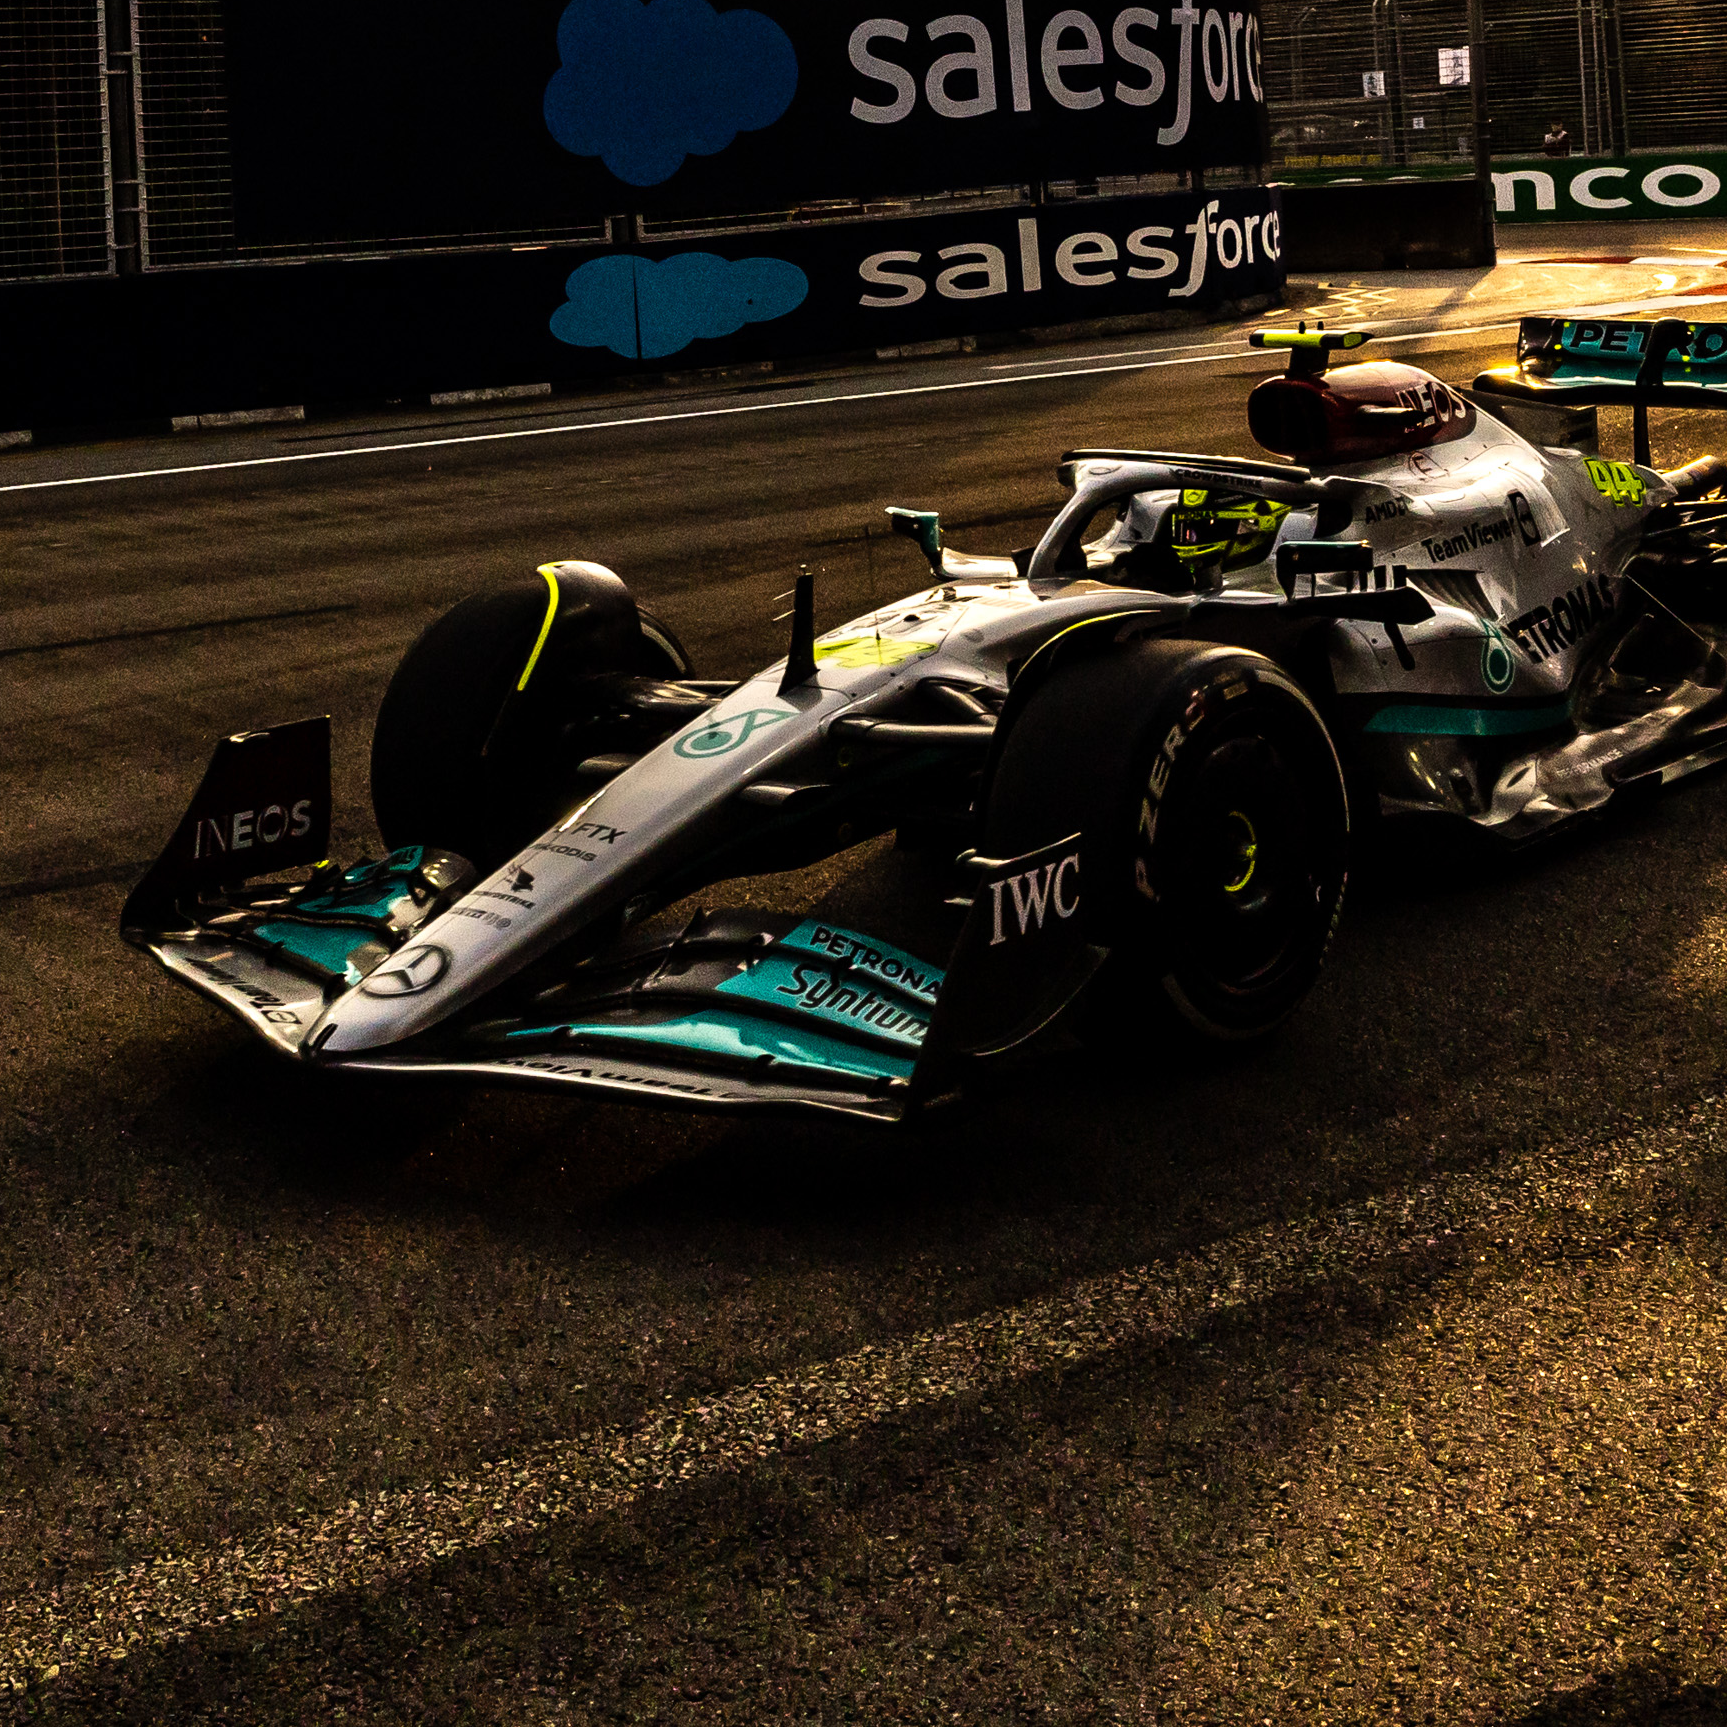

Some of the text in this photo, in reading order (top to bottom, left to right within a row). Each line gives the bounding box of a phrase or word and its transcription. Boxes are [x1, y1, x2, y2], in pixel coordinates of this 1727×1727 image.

[1583, 457, 1646, 507] 44
[1365, 499, 1399, 524] AMD
[1421, 516, 1515, 563] TeamViewer
[1500, 574, 1613, 664] ETRONAS
[193, 798, 313, 859] INEOS
[571, 823, 626, 844] FTX
[988, 852, 1081, 947] IWC
